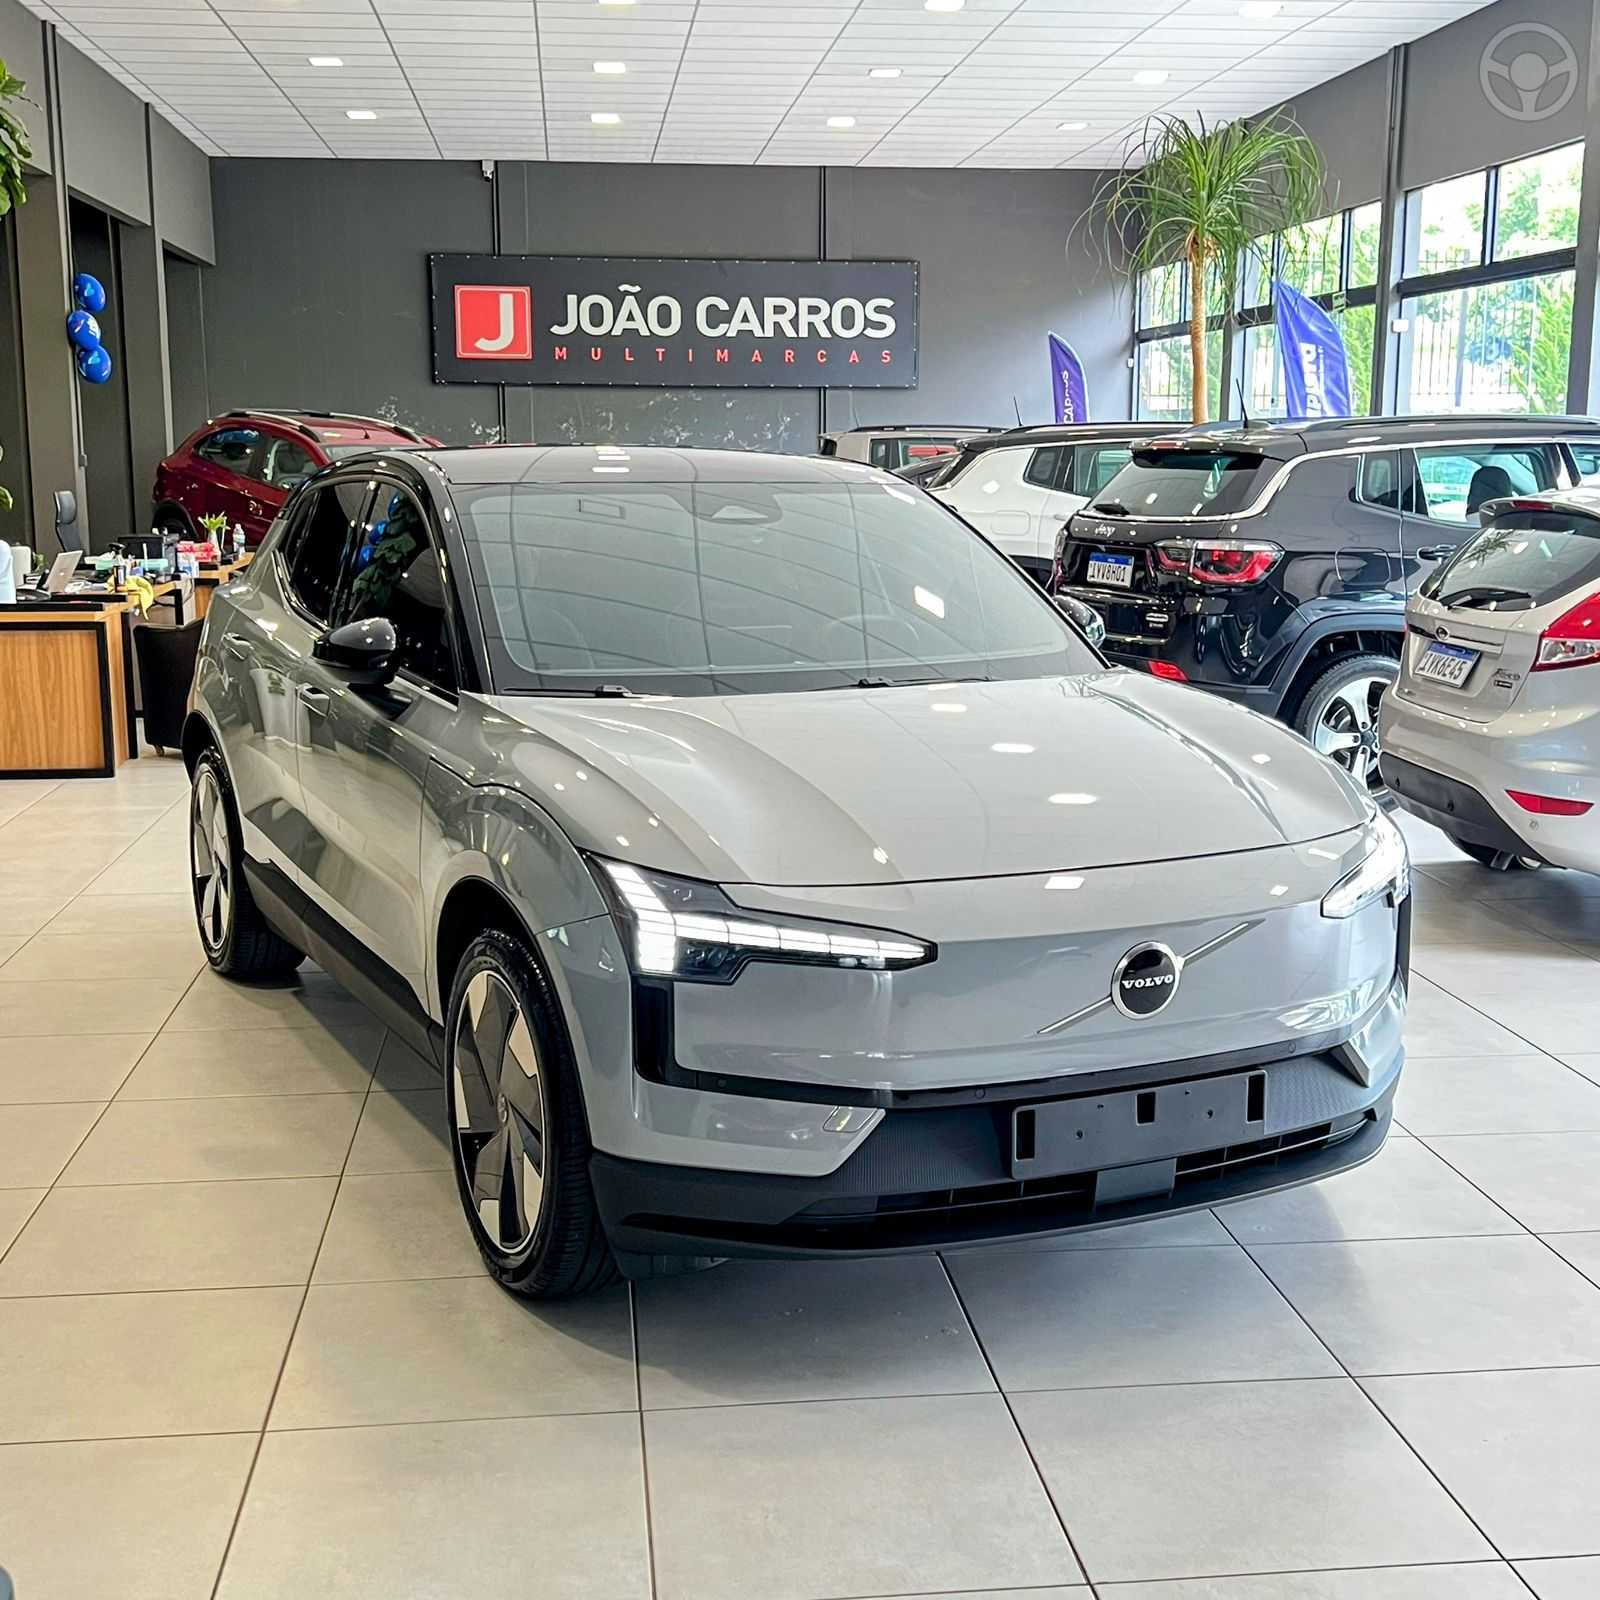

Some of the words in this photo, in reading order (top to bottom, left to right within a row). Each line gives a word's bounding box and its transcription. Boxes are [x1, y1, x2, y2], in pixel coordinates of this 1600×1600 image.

[474, 293, 514, 352] J
[550, 283, 682, 337] JOÃO
[696, 296, 897, 339] CARROS
[553, 346, 893, 364] MULTIMARCAS
[1121, 974, 1174, 989] VOLVO
